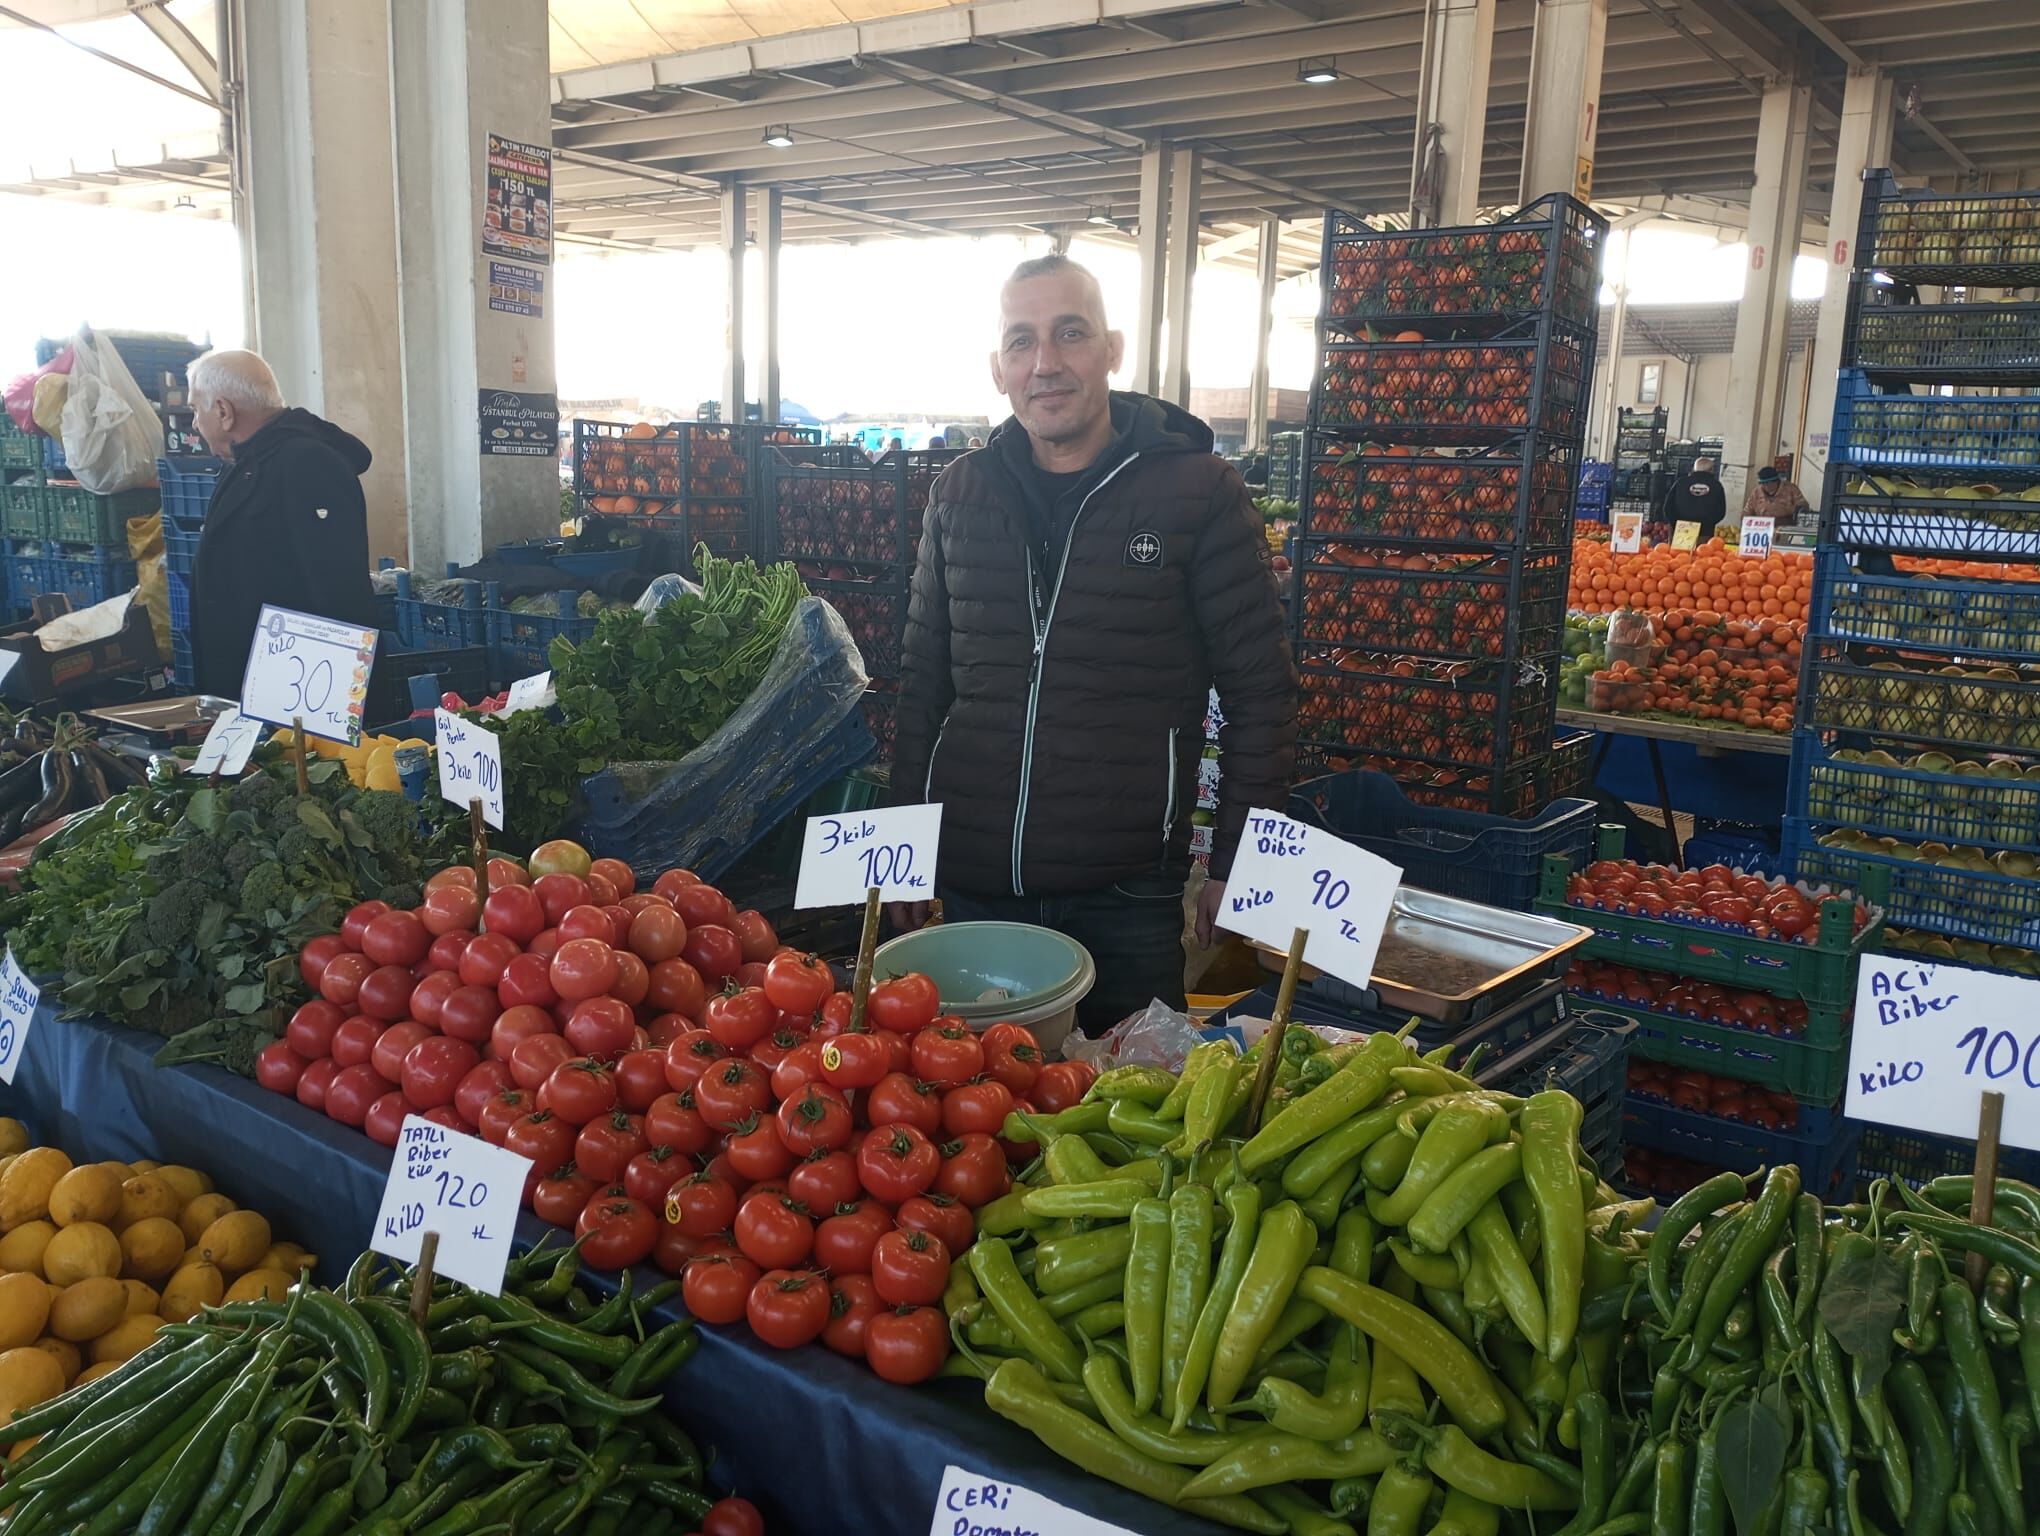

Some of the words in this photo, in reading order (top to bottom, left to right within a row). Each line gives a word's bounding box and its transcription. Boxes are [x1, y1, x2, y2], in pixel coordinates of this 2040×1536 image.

[1585, 102, 1594, 142] 7
[502, 178, 524, 194] 150
[526, 186, 535, 197] TL
[1752, 245, 1765, 270] 6
[1834, 239, 1848, 266] 6
[1744, 532, 1769, 547] 100
[283, 655, 333, 713] 30
[445, 751, 457, 781] 3
[473, 751, 498, 792] 100
[820, 819, 842, 854] 3
[858, 843, 913, 889] 100
[1311, 869, 1350, 910] 90
[1878, 994, 1959, 1026] Biber
[407, 1144, 452, 1162] Biber
[435, 1171, 488, 1208] 120
